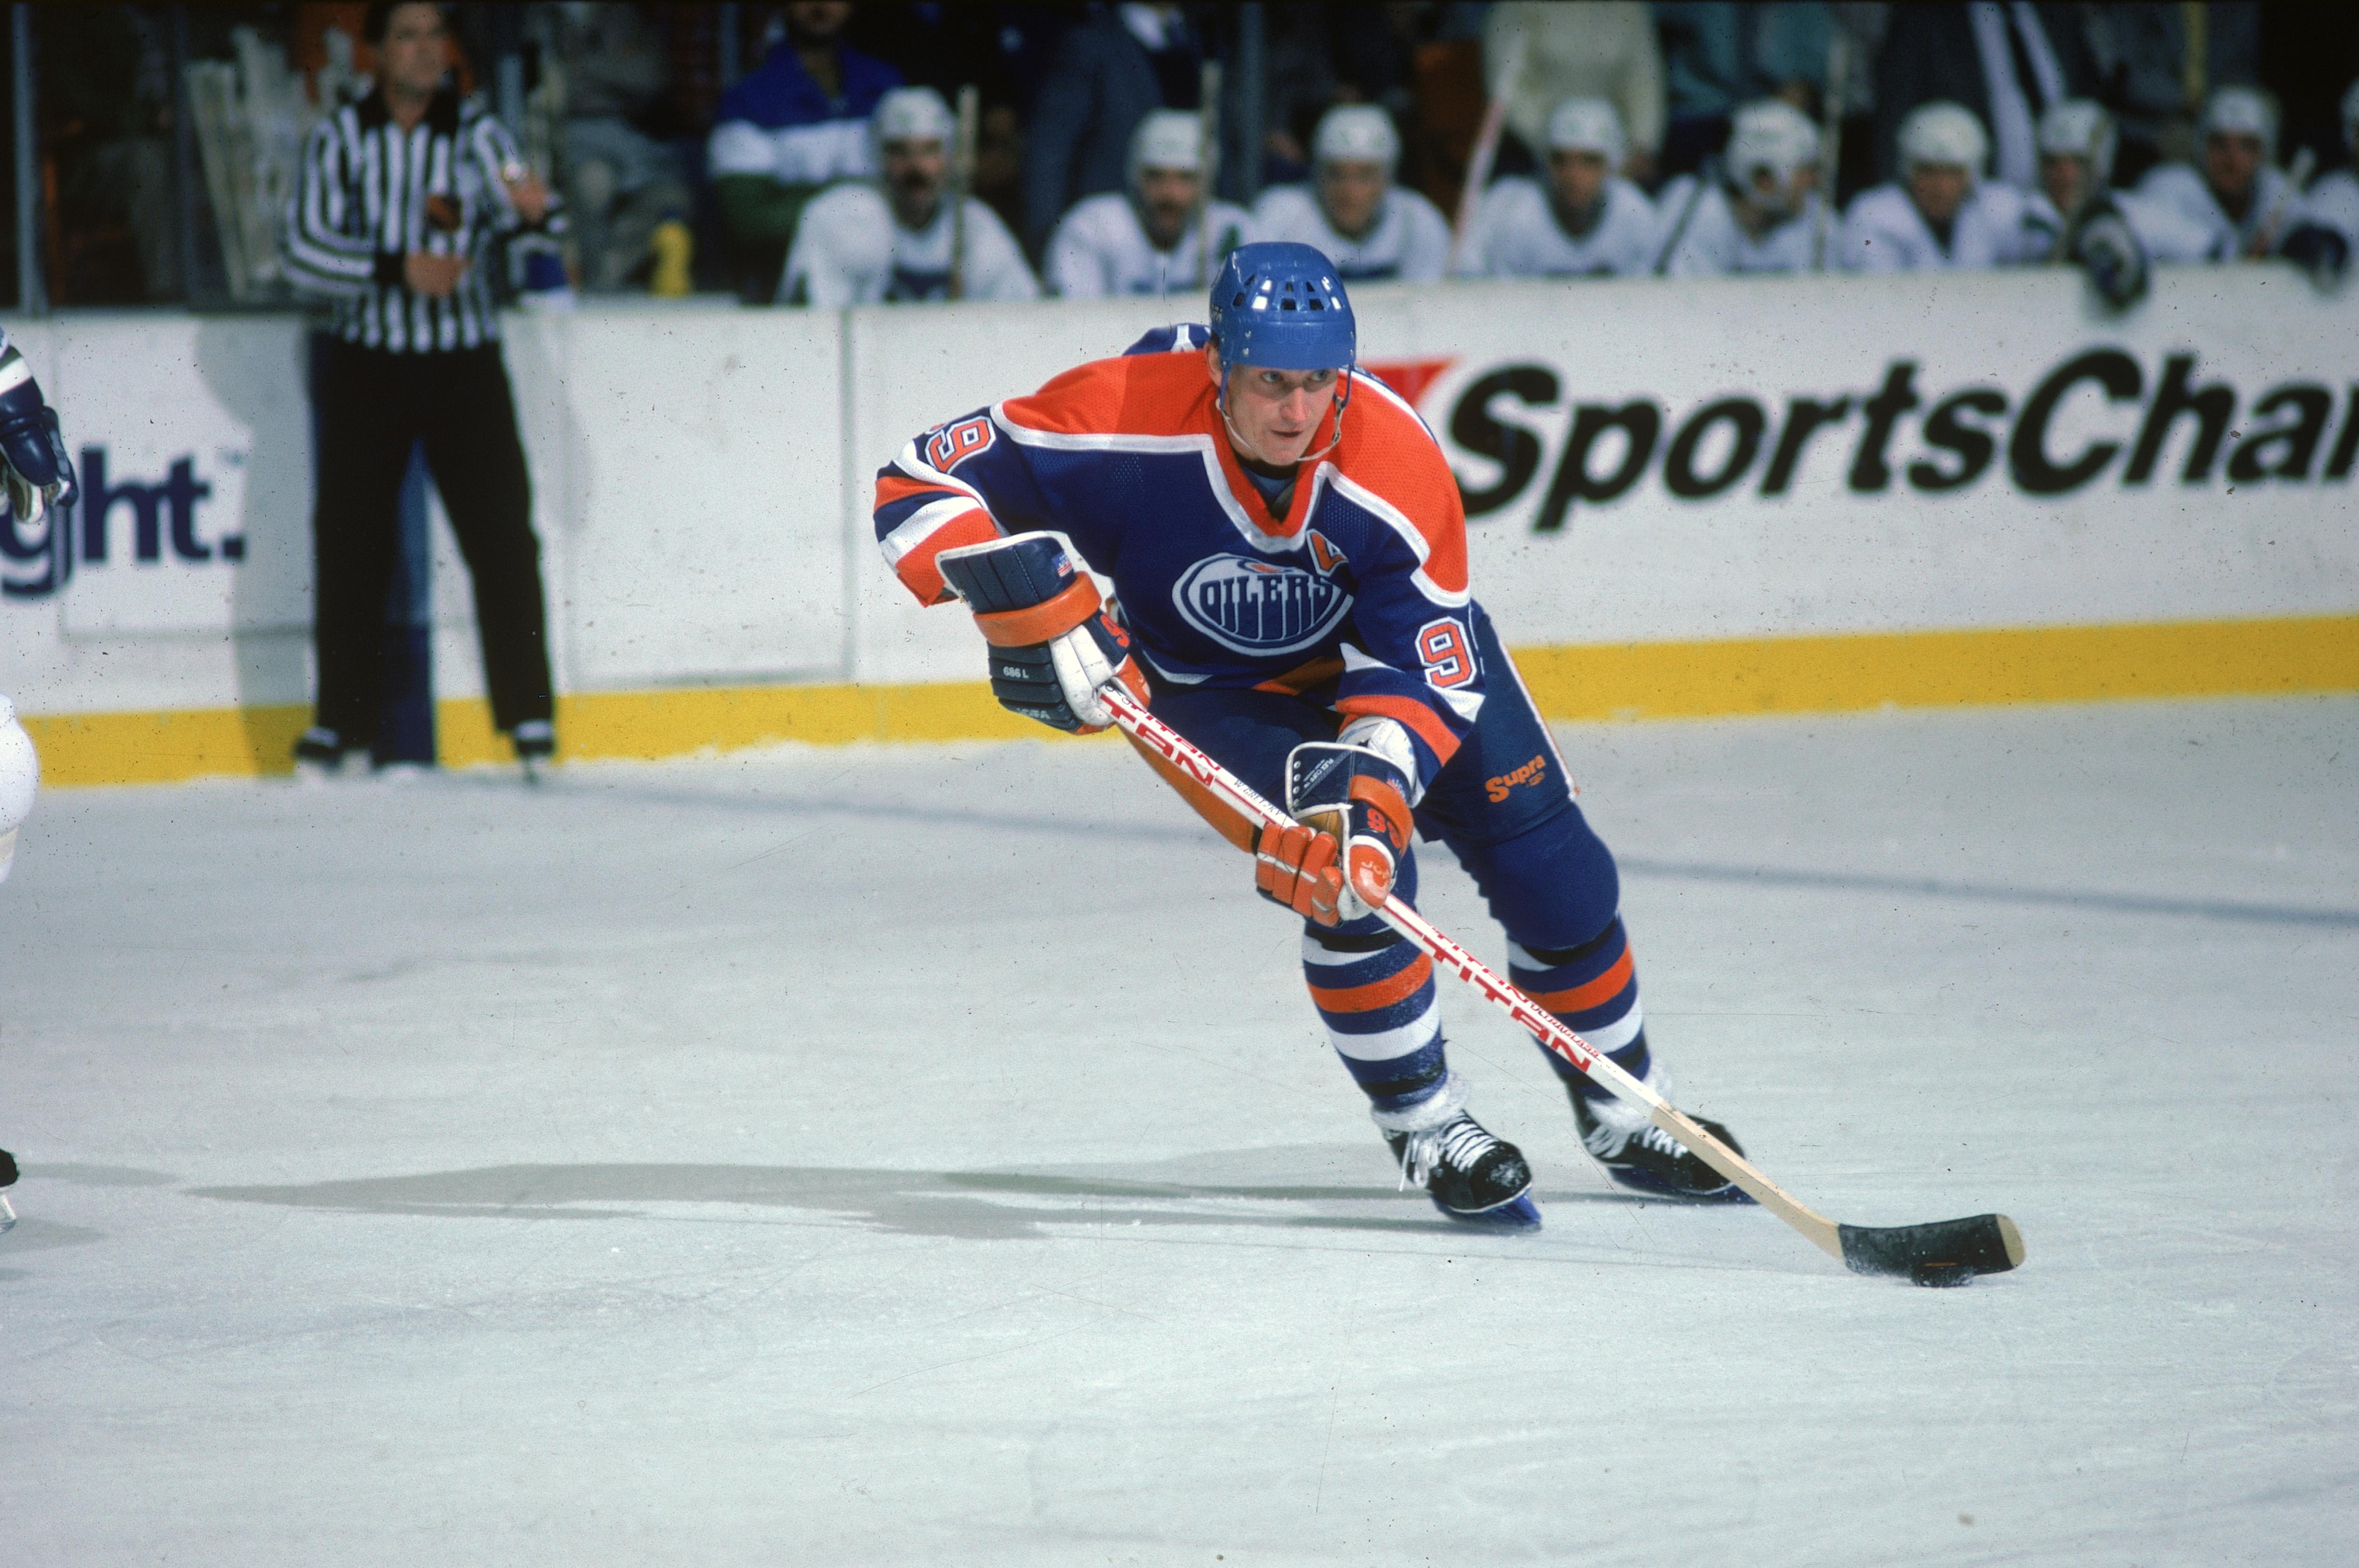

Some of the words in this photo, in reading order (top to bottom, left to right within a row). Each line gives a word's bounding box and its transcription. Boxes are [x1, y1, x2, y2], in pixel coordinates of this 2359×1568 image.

[924, 416, 996, 475] 9
[1199, 574, 1333, 641] OILERS
[1003, 666, 1021, 678] 686
[1022, 668, 1029, 678] L
[1414, 616, 1478, 689] 9
[1485, 755, 1546, 802] Supra
[1422, 934, 1592, 1072] TITAN
